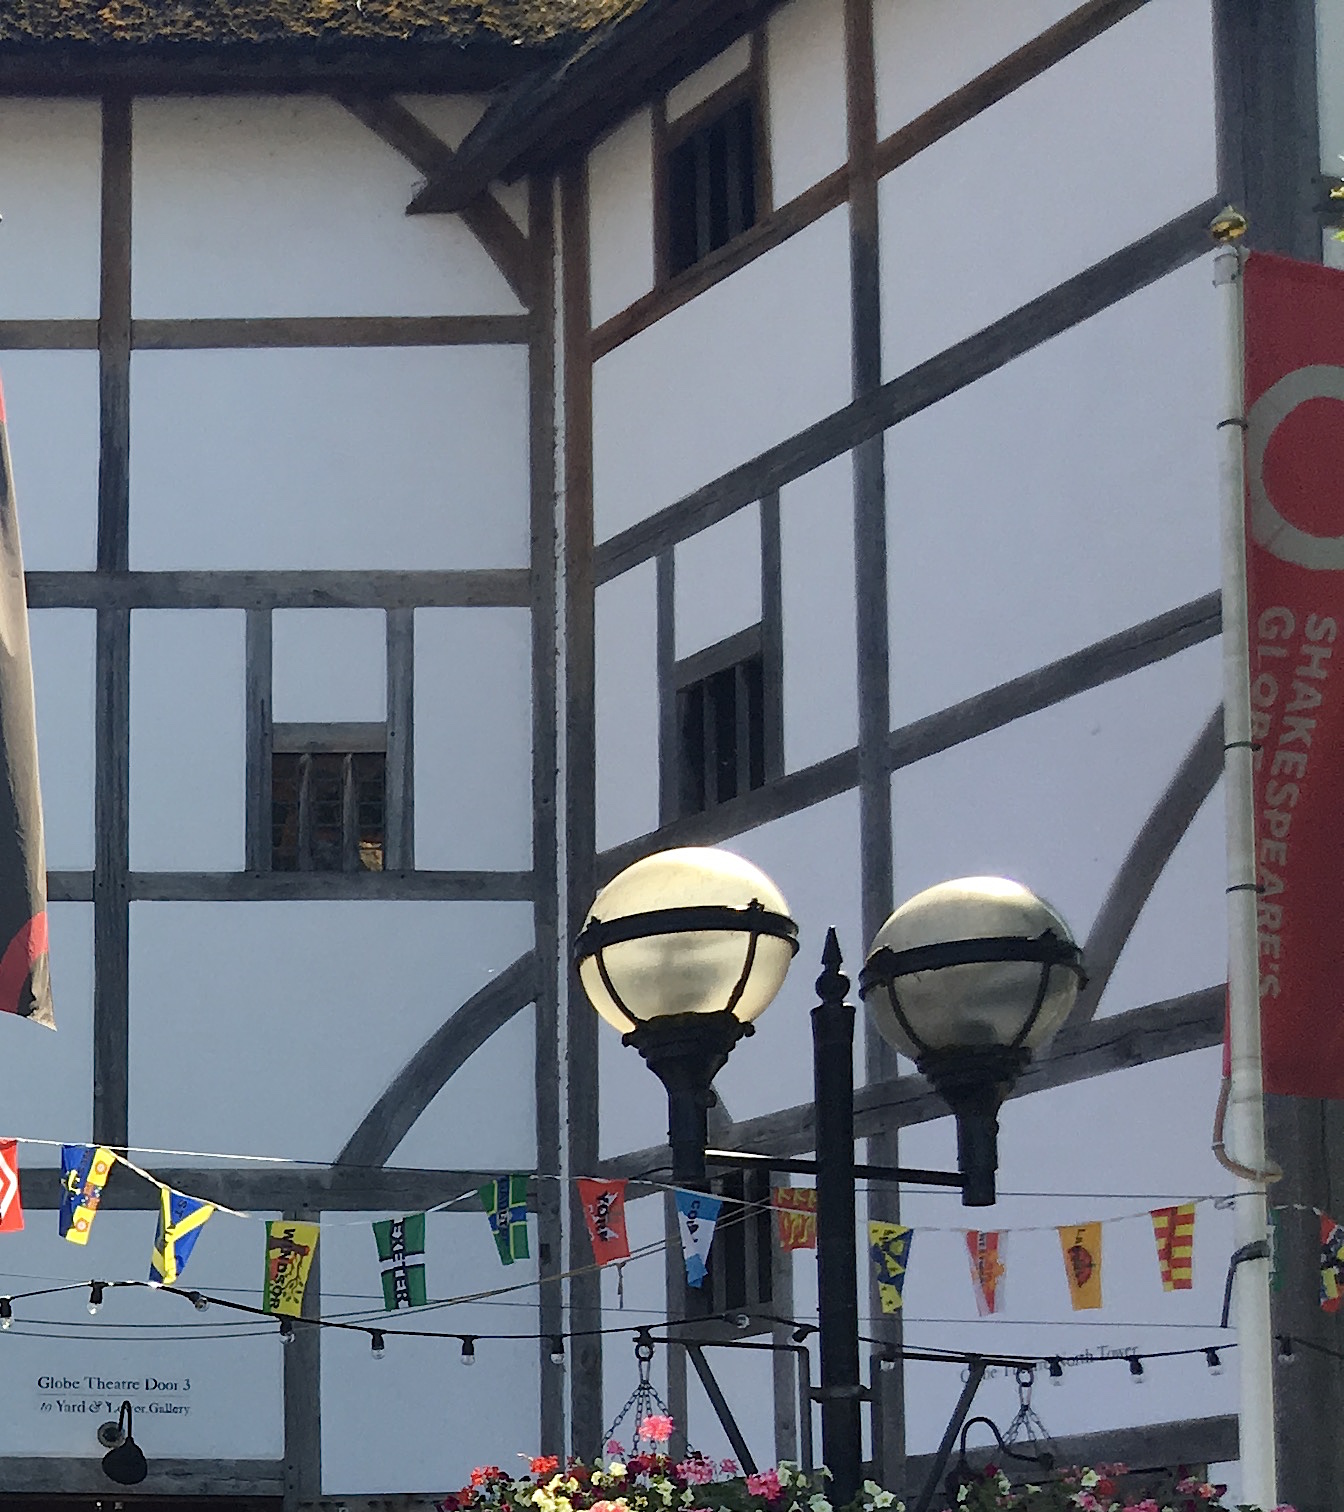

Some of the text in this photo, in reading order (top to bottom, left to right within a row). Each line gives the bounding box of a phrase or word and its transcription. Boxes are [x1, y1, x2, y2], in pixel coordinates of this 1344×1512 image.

[1258, 611, 1338, 1001] SHAKESPEARE'S
[37, 1376, 192, 1391] Globe Theatre Door 3
[40, 1402, 53, 1413] to
[56, 1400, 86, 1413] Yard
[88, 1400, 103, 1413] &
[148, 1402, 191, 1417] Gallery
